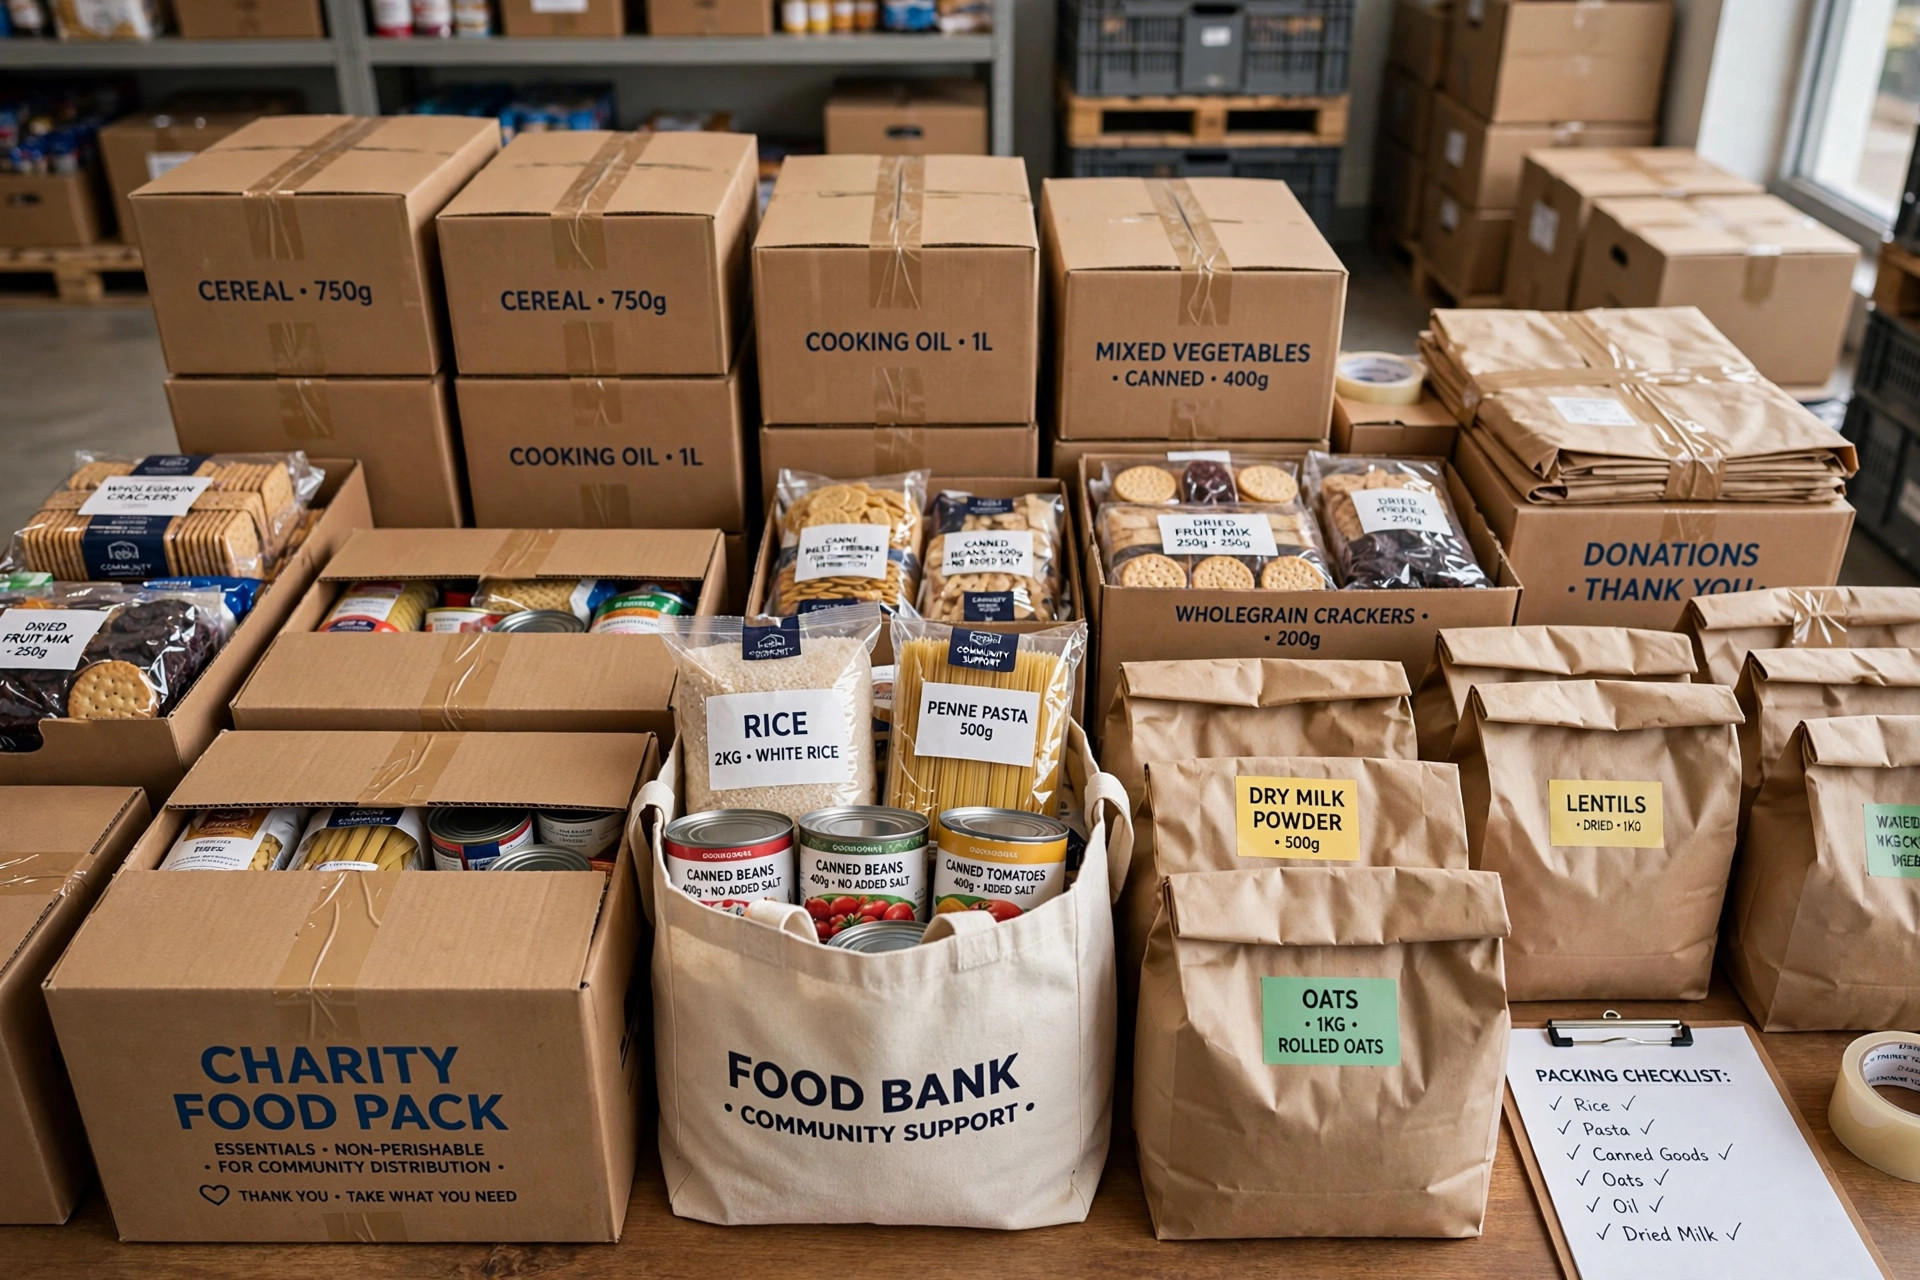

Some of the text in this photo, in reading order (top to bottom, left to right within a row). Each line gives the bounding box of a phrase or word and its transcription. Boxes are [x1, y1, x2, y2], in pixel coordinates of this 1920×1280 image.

[199, 280, 373, 306] CEREAL 750g
[501, 290, 667, 316] CEREAL 750g
[805, 331, 993, 352] COOKING OIL 1L
[1095, 341, 1311, 363] MIXED VEGETABLES
[1125, 370, 1268, 391] CANNED 400g
[510, 447, 703, 468] COOKING OIL 1L
[107, 493, 178, 501] CRACKERS
[1193, 519, 1235, 527] DRIED
[1175, 528, 1252, 537] FRUIT MIX
[1176, 538, 1251, 549] 250g 250g
[1584, 542, 1760, 567] DONATIONS
[1585, 578, 1684, 601] THANK
[1175, 605, 1415, 625] WHOLEGRAIN CRACKERS
[25, 622, 67, 632] DRIED
[2, 633, 74, 644] FRUIT MIX
[1277, 631, 1321, 650] 200g
[14, 646, 48, 659] 250g
[927, 700, 1029, 724] PENNE PASTA
[744, 711, 808, 739] RICE
[960, 722, 993, 741] 500g
[715, 745, 839, 766] 2KG WHITE RICE
[1250, 787, 1345, 807] DRY MILK
[1567, 794, 1646, 813] LENTILS
[1253, 811, 1342, 831] POWDER
[1583, 819, 1613, 831] DRIED
[1285, 836, 1320, 853] 500g
[687, 864, 774, 882] CANNED BEANS
[816, 859, 903, 875] CANNED BEANS
[946, 859, 1046, 881] CANNED TOMATOES
[682, 877, 782, 897] 400g NO ADDED SALT
[810, 874, 910, 889] 400g NO ADDED SALT
[954, 877, 1036, 894] 400g ADDED SALT
[1302, 989, 1359, 1010] OATS
[1316, 1016, 1346, 1032] 1KG
[1278, 1038, 1384, 1054] ROLLED OATS
[201, 1046, 459, 1084] CHARITY
[728, 1050, 1020, 1113] FOOD BANK
[1536, 1069, 1731, 1084] PACKING CHECKLIST:
[173, 1093, 509, 1131] FOOD PACK
[1574, 1099, 1611, 1113] Rice
[741, 1102, 1018, 1143] COMMUNITY SUPPORT
[1583, 1123, 1630, 1137] Pasta
[214, 1142, 484, 1157] ESSENTIALS NON-PERISHABLE
[1592, 1147, 1709, 1162] Canned Goods
[218, 1160, 491, 1174] FOR COMMUNITY DISTRIBUTION
[1602, 1172, 1644, 1188] Oats
[238, 1190, 517, 1203] THANK YOU TAKE WHAT YOU NEED
[1613, 1198, 1639, 1214] Oil
[1624, 1226, 1718, 1242] Dried Milk
